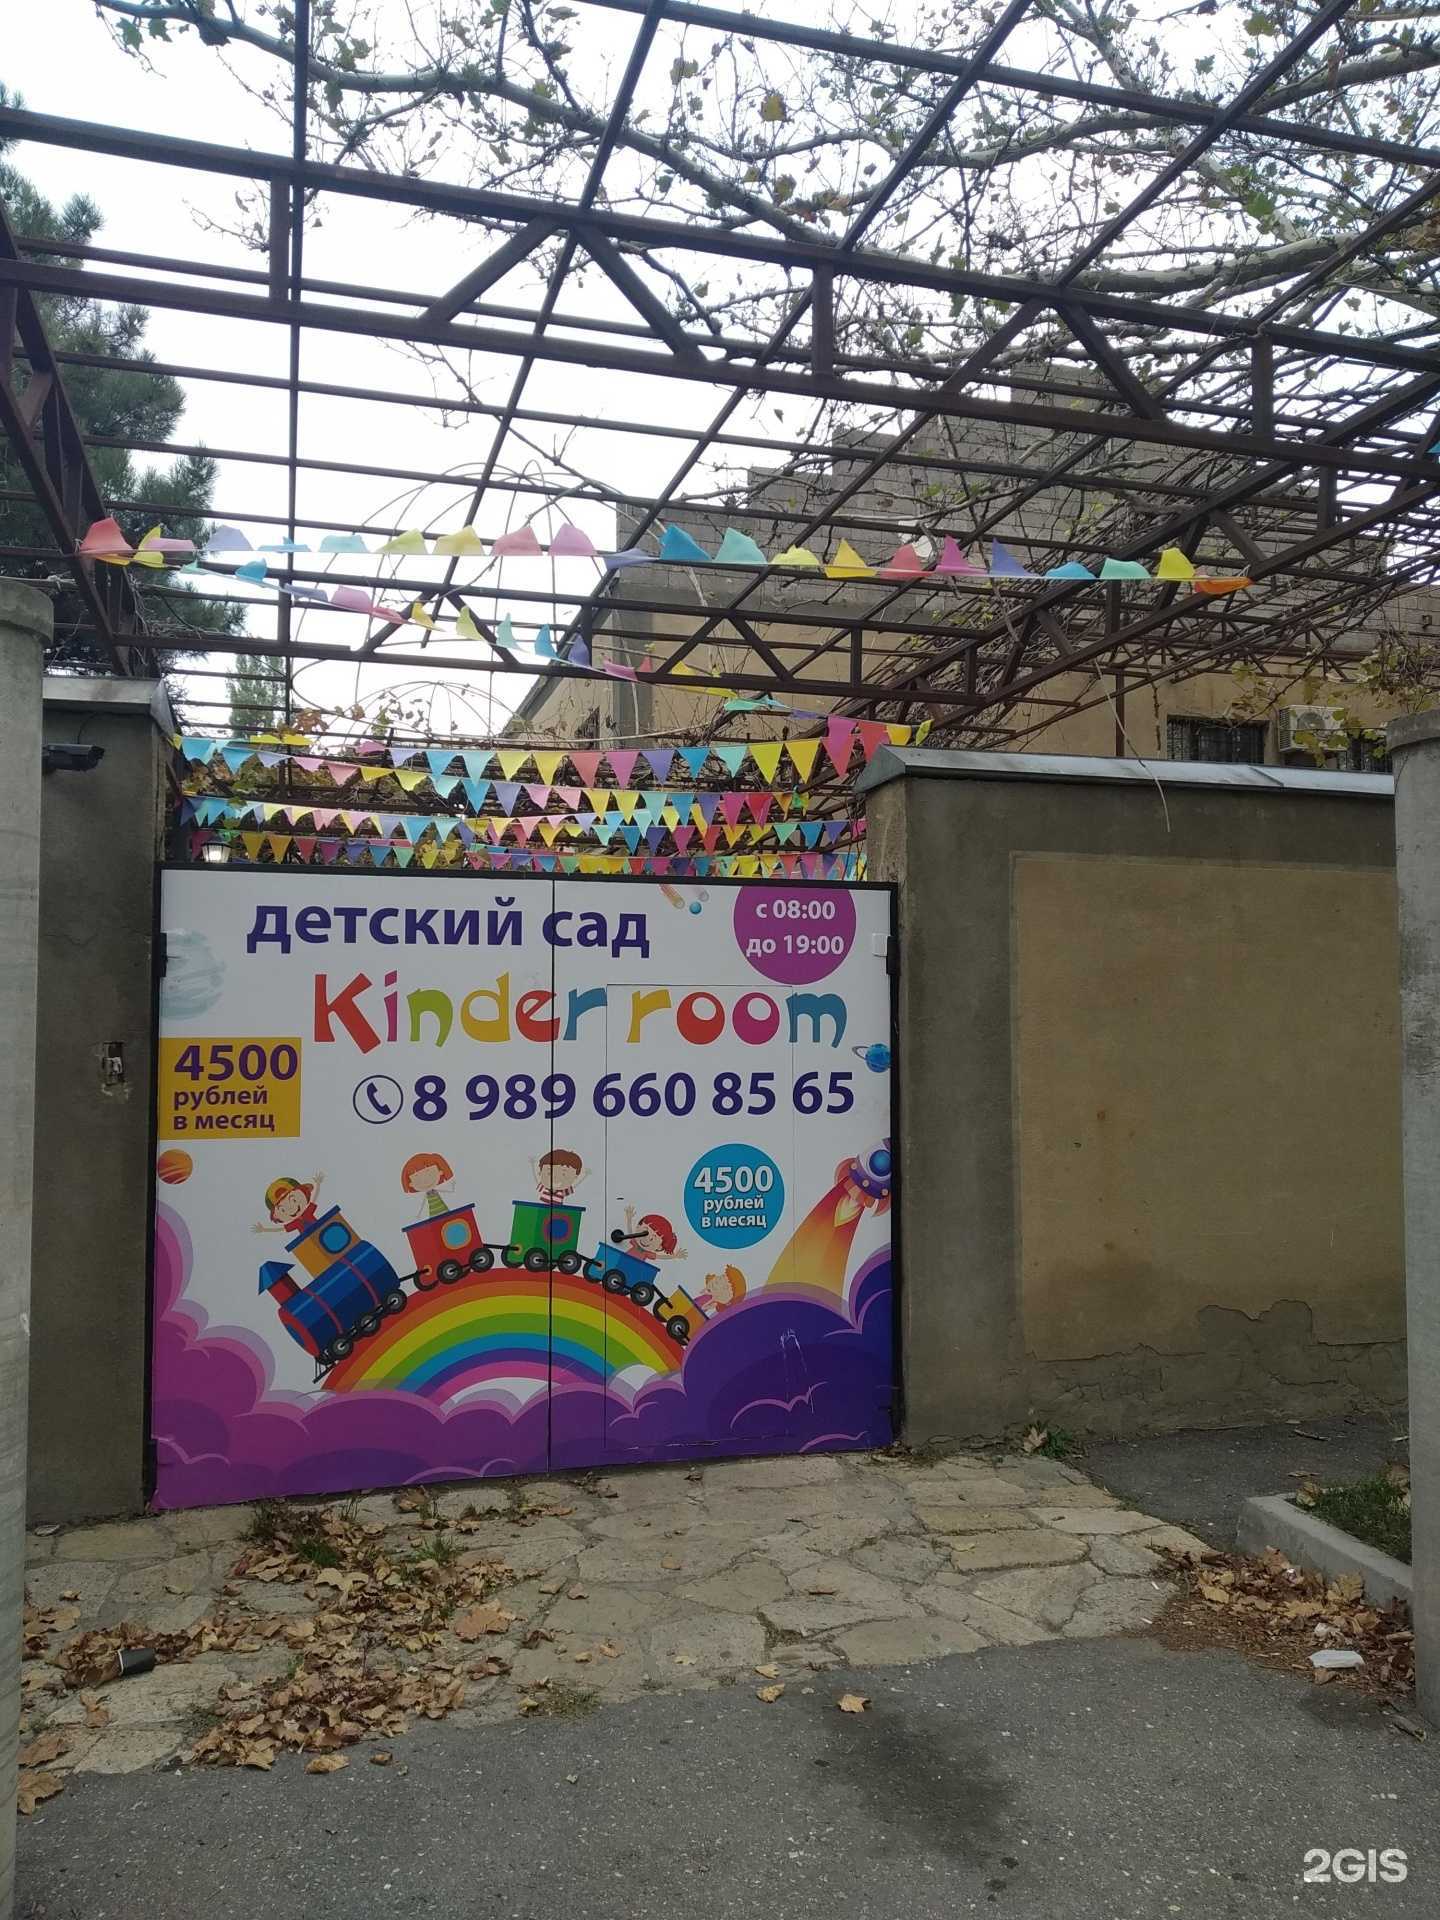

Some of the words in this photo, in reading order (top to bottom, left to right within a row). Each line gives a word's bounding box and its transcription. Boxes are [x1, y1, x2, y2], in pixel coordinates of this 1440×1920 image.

[756, 903, 767, 919] с
[772, 900, 836, 920] 08:00
[247, 896, 523, 954] детский
[542, 910, 650, 958] сад
[746, 938, 776, 957] до
[784, 935, 845, 955] 19:00
[314, 970, 608, 1054] Kinder
[626, 988, 848, 1048] room
[174, 1044, 298, 1081] 4500
[174, 1086, 268, 1111] рублей
[412, 1075, 448, 1122] 8
[465, 1073, 576, 1120] 989
[593, 1071, 696, 1118] 660
[712, 1071, 776, 1116] 85
[793, 1071, 855, 1115] 65
[173, 1114, 188, 1130] в
[195, 1111, 275, 1132] месяц
[694, 1165, 774, 1193] 4500
[703, 1195, 764, 1214] рублей
[701, 1216, 711, 1228] в
[715, 1214, 767, 1228] месяц
